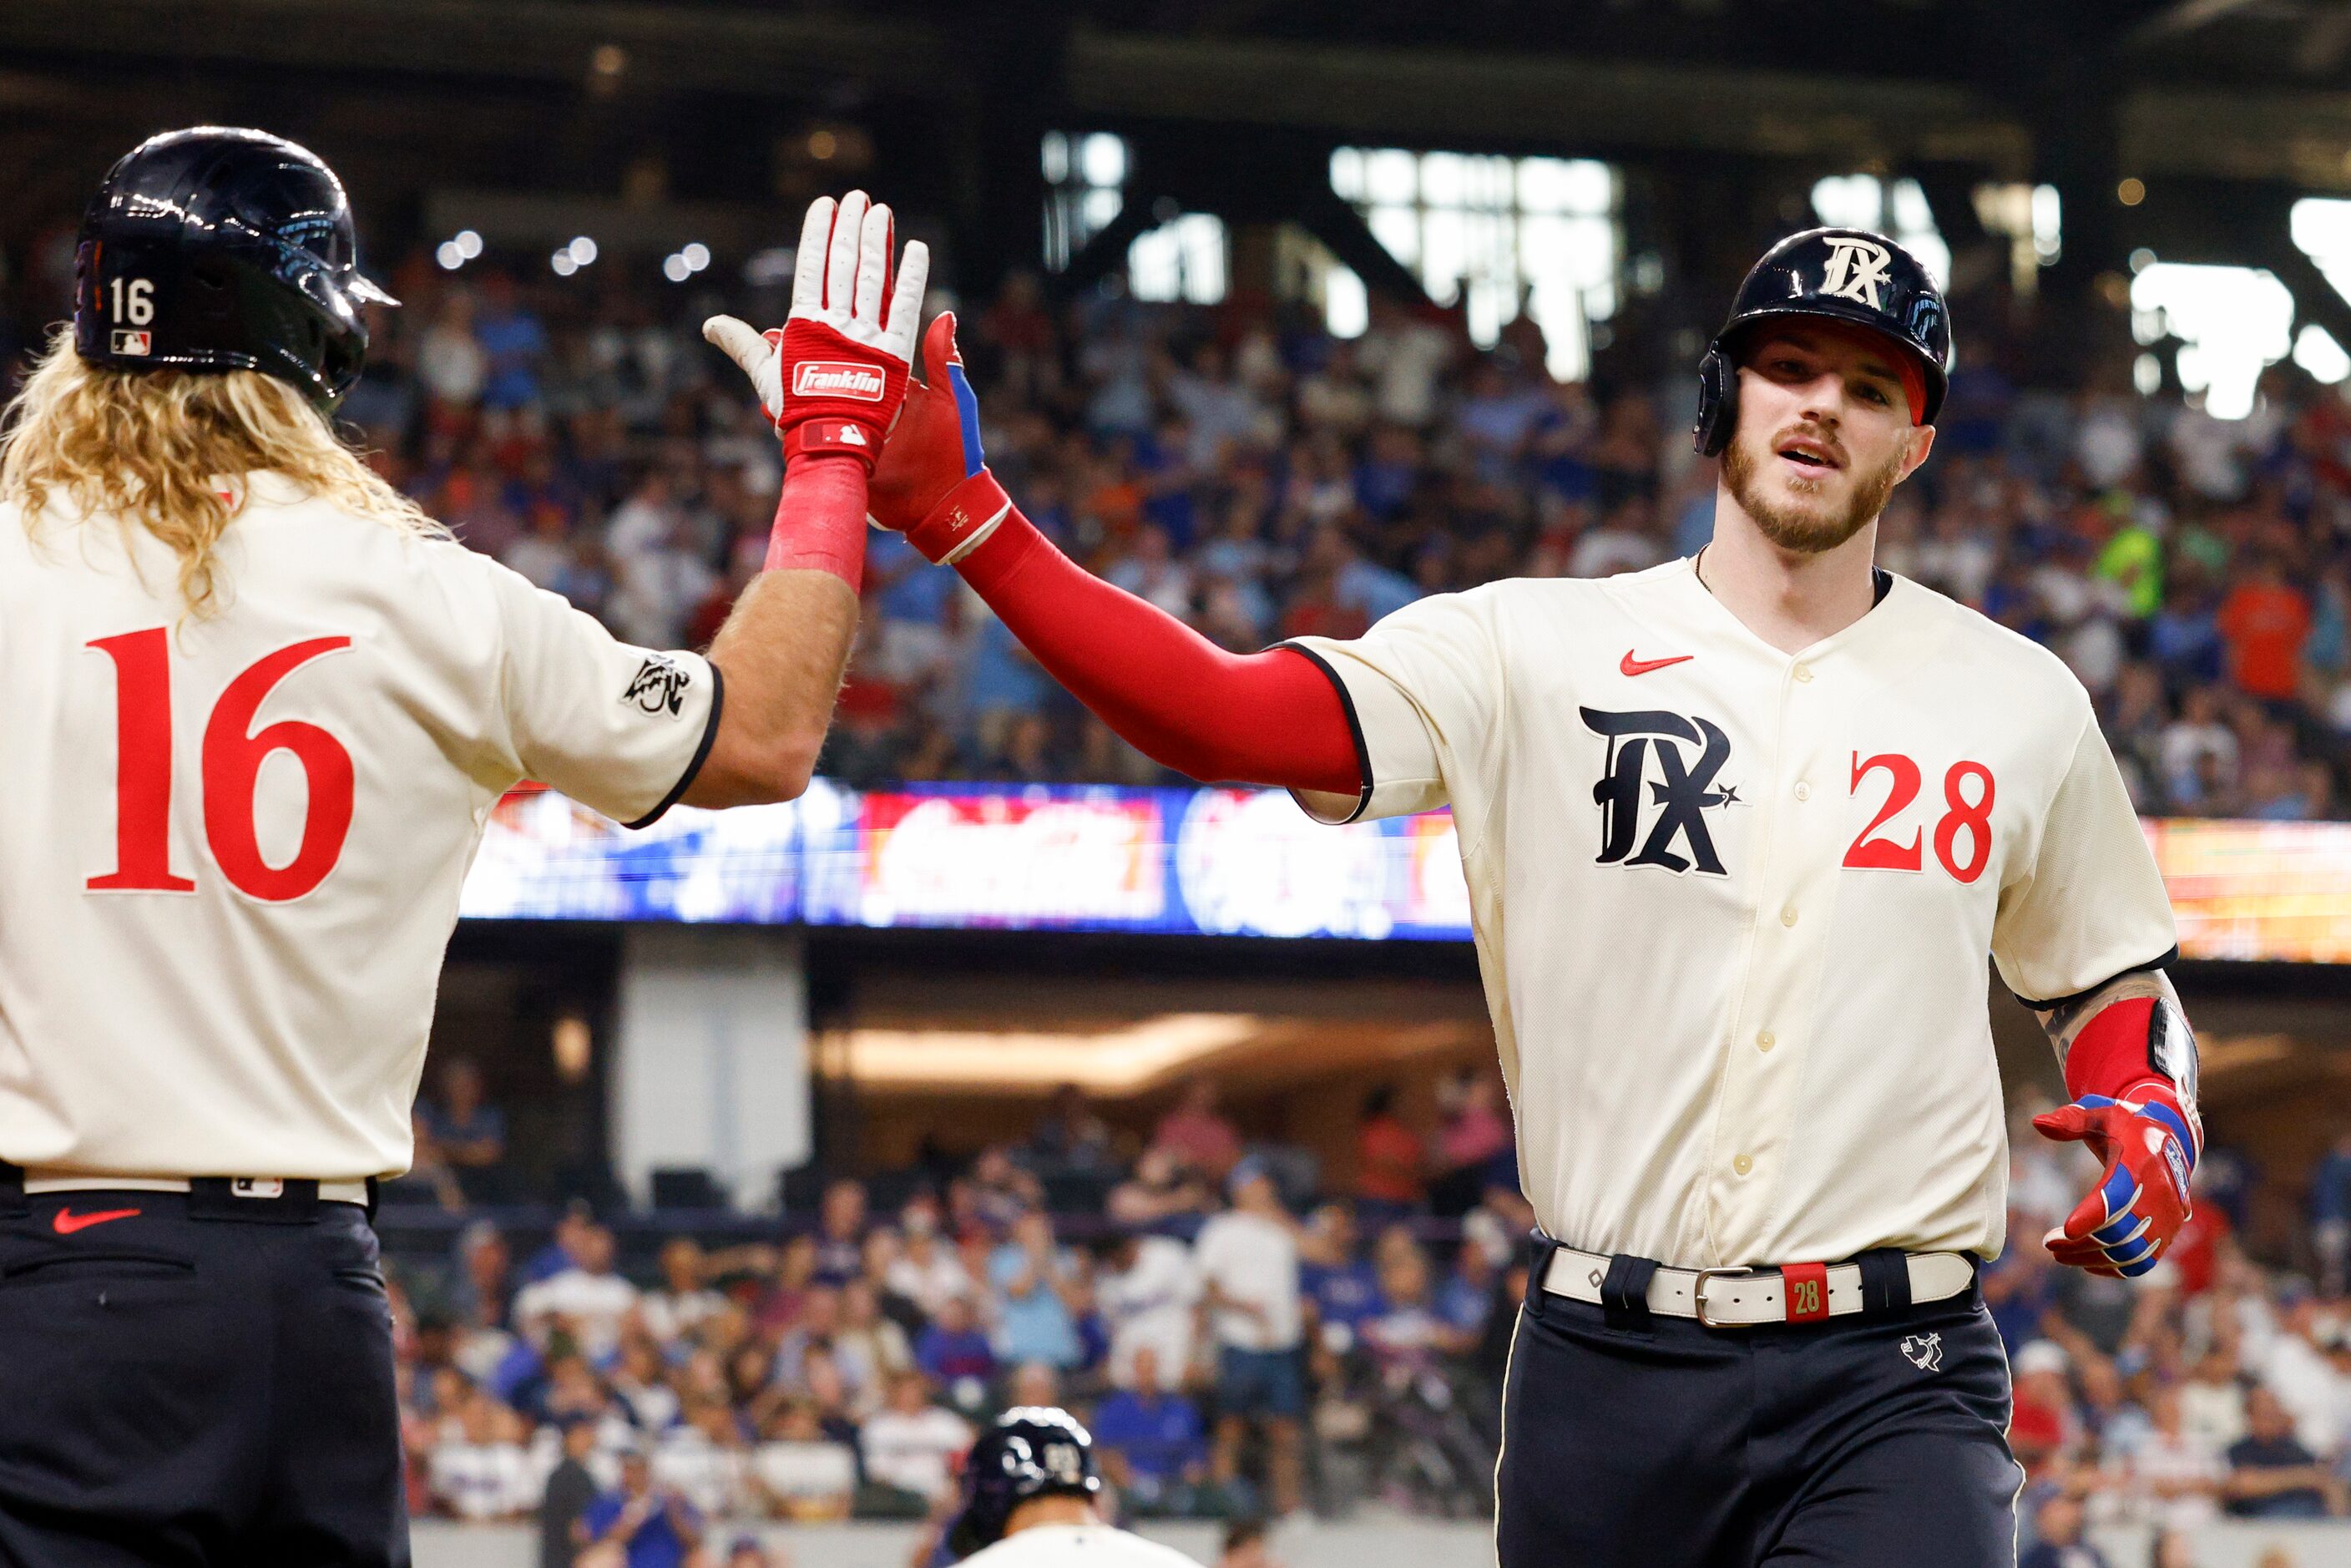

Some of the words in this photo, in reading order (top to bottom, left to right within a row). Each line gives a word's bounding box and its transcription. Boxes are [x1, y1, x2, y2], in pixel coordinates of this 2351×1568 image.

[110, 277, 154, 326] 16
[796, 366, 881, 392] Franklin
[85, 626, 355, 902] 16
[1842, 750, 1995, 884] 28
[1794, 1280, 1820, 1314] 28
